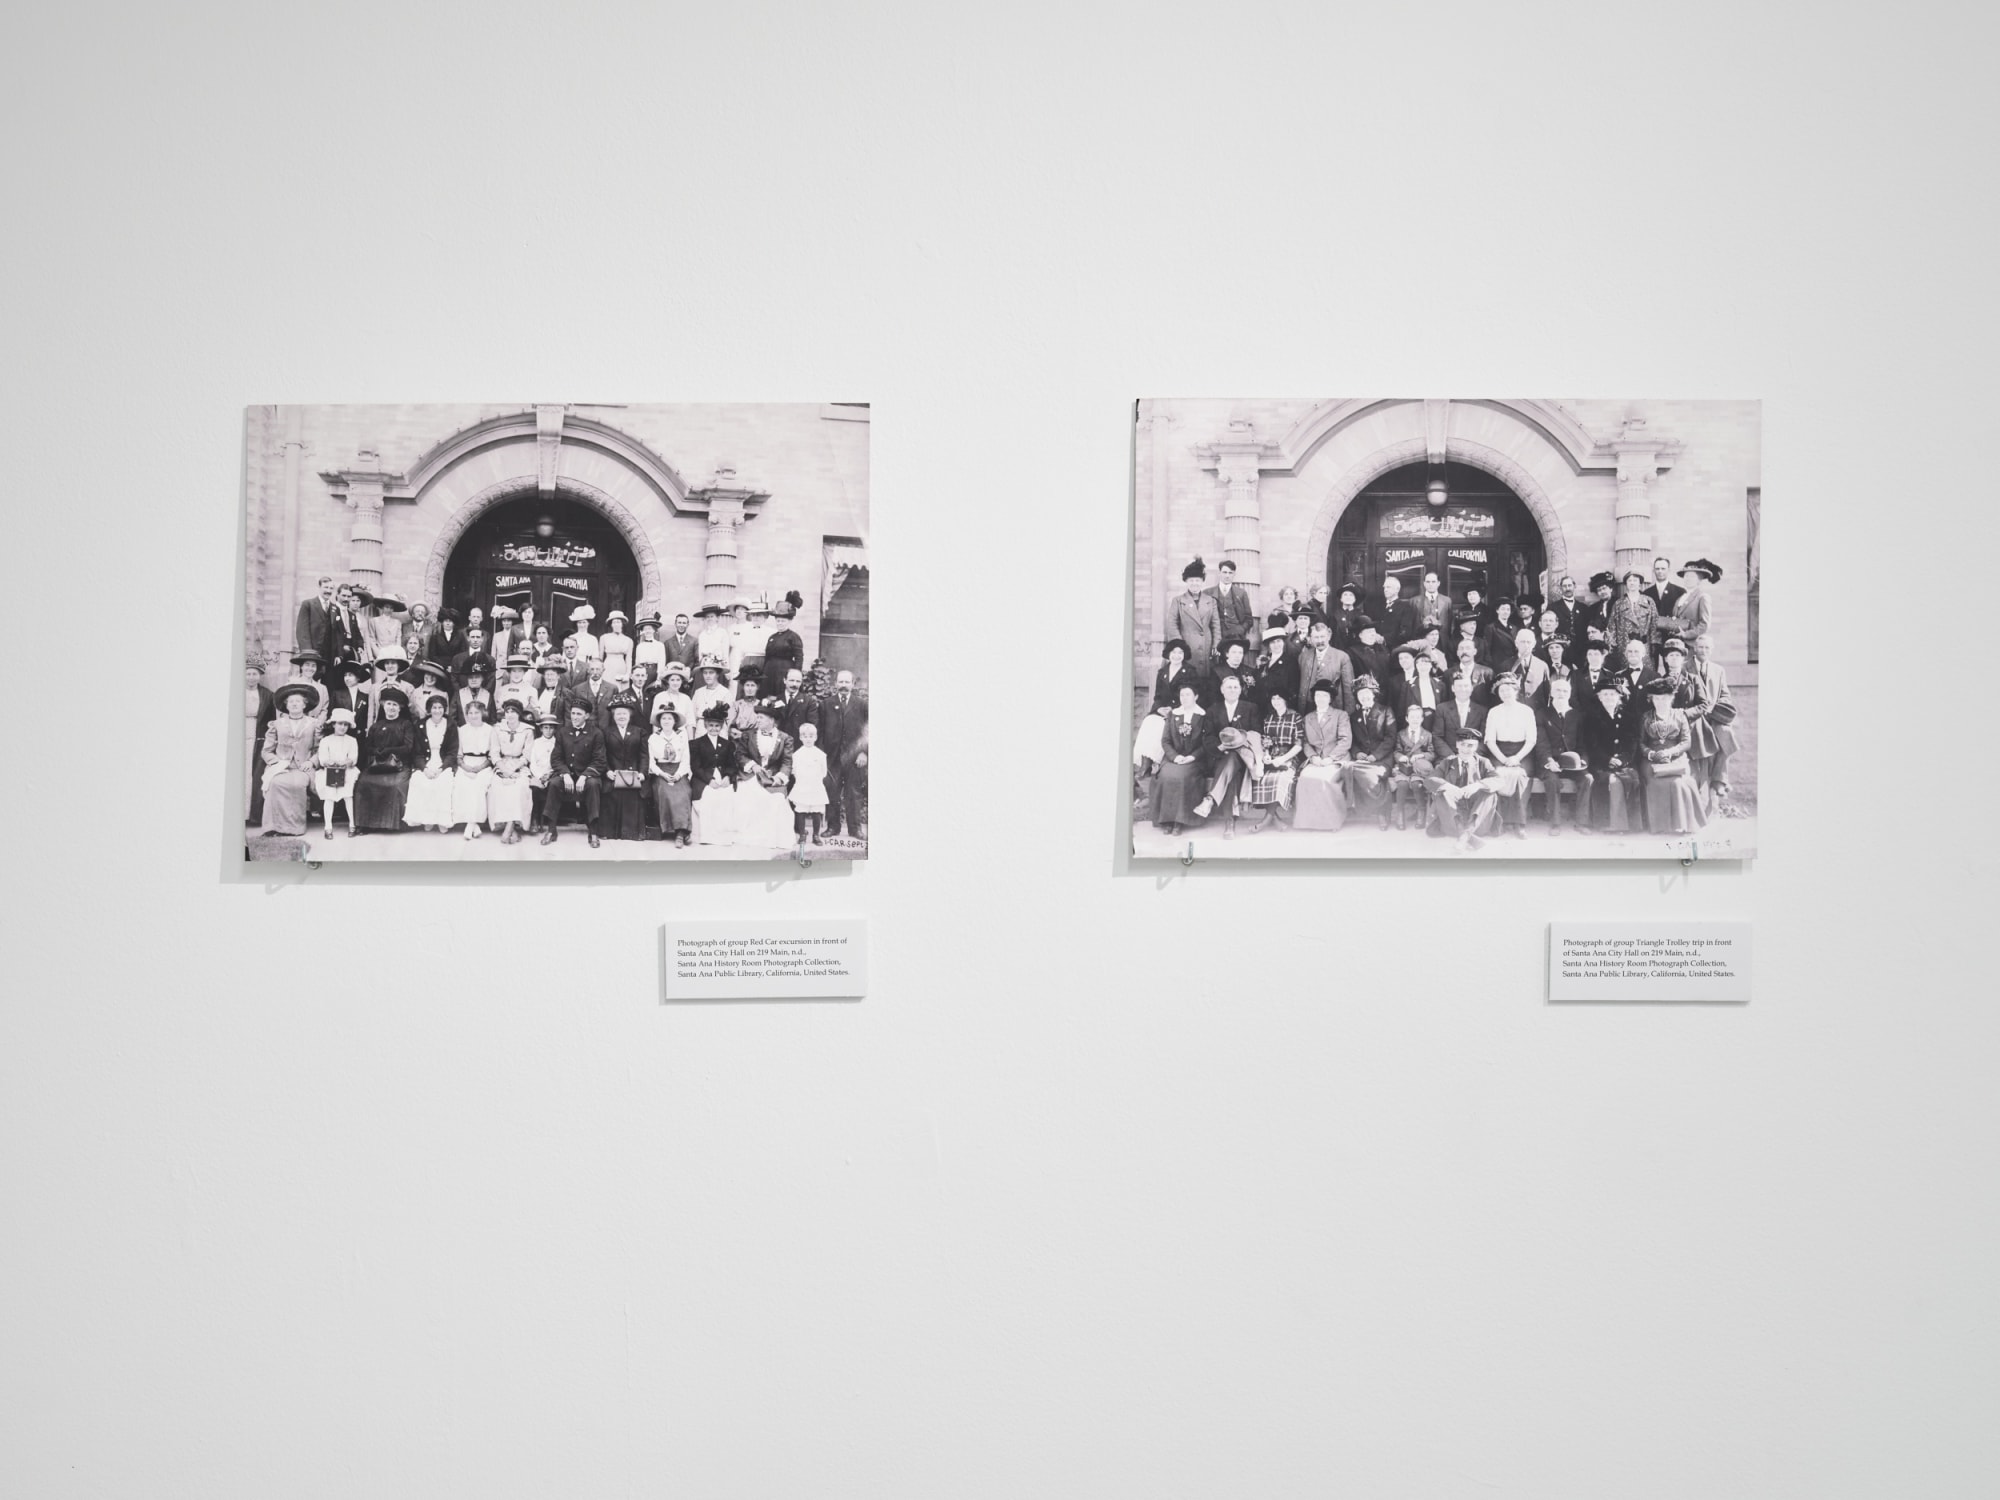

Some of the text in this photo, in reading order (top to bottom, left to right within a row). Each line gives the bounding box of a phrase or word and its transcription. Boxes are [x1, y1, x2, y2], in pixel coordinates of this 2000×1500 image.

[1385, 550, 1424, 562] SANTA ANA
[1448, 550, 1487, 562] CALIFORNIA
[496, 576, 518, 587] SANTA
[553, 578, 588, 590] CALIFORNIA
[677, 938, 718, 948] Photograph
[719, 938, 726, 946] of
[728, 939, 749, 947] group
[750, 937, 764, 946] Red
[765, 937, 778, 945] Car
[813, 937, 821, 945] in
[821, 937, 839, 945] front
[840, 936, 847, 945] of
[1563, 938, 1604, 948] Photograph
[1605, 938, 1612, 946] of
[1613, 940, 1635, 948] group
[1636, 938, 1665, 948] Triangle
[1666, 938, 1691, 948] Trolley
[1692, 938, 1705, 948] trip
[1714, 938, 1732, 946] front
[677, 948, 697, 957] Santa
[698, 948, 713, 956] Ana
[714, 948, 729, 958] City
[730, 948, 745, 956] Hall
[757, 948, 769, 956] 219
[770, 948, 790, 957] Main,
[1563, 948, 1571, 957] of
[1571, 948, 1591, 957] Santa
[1592, 948, 1607, 957] Ana
[1608, 948, 1623, 958] City
[1624, 948, 1639, 957] Hall
[1651, 948, 1663, 957] 219
[1664, 948, 1684, 957] Main,
[677, 958, 842, 969] Santa Ana History Room Photograph Collection,
[1562, 959, 1727, 969] Santa Ana History Room Photograph Collection,
[677, 968, 850, 979] Santa Ana Public Library, California, United States.
[1562, 970, 1735, 979] Santa Ana Public Library, California, United States.
